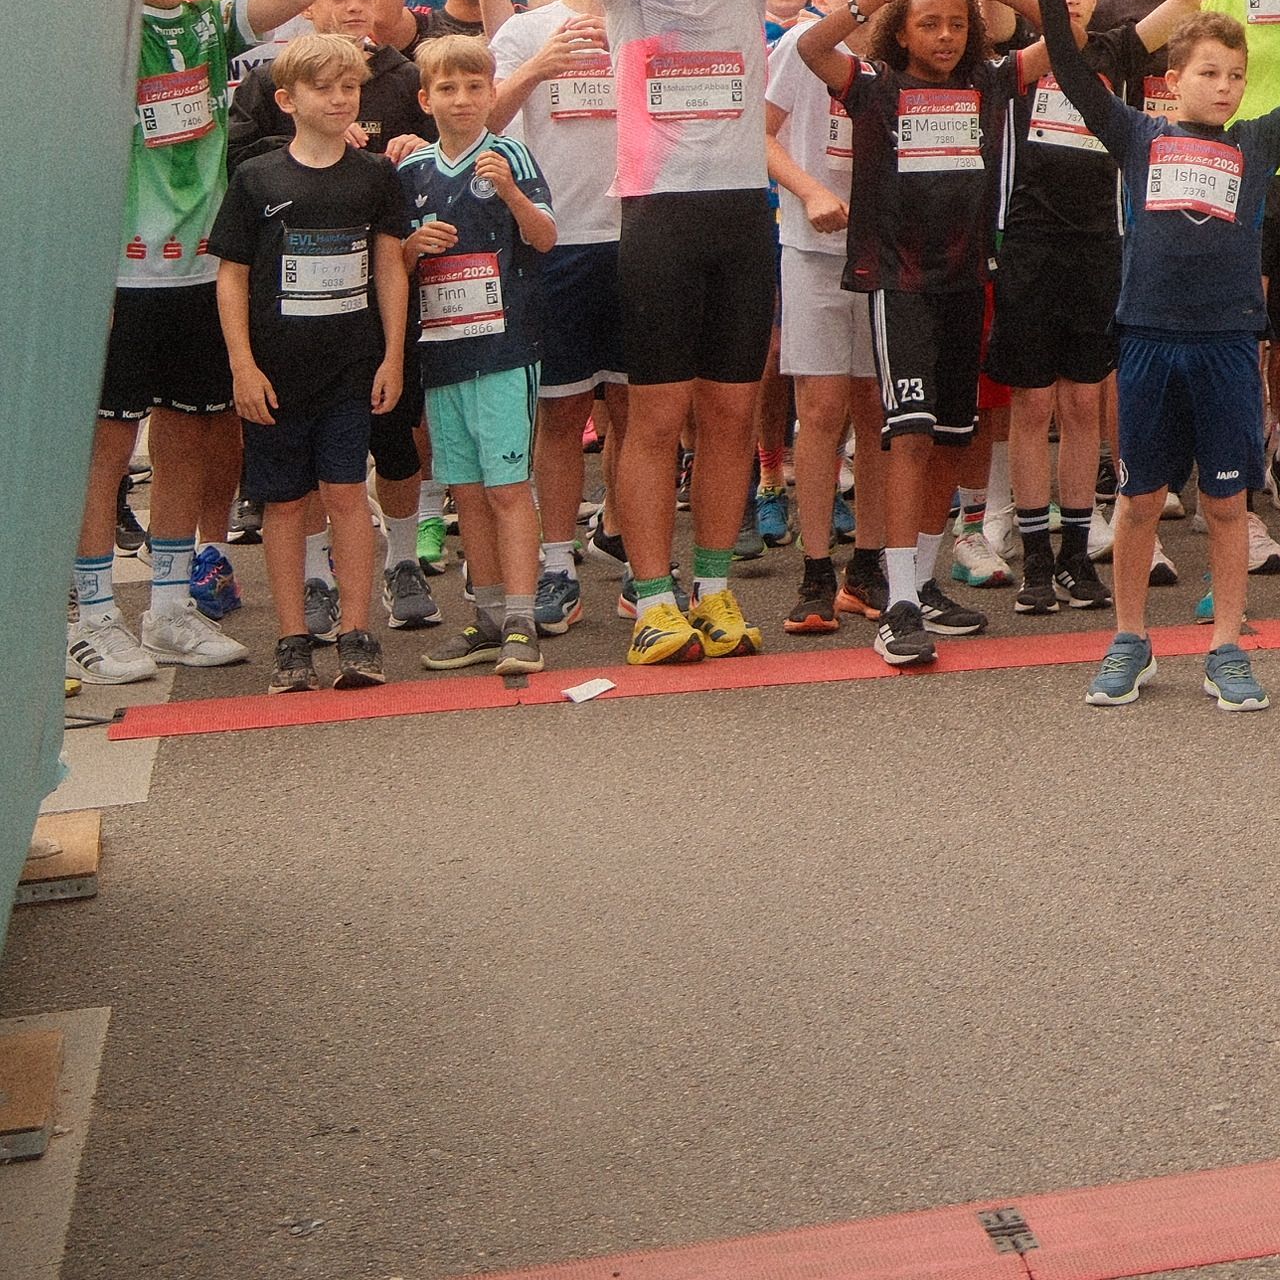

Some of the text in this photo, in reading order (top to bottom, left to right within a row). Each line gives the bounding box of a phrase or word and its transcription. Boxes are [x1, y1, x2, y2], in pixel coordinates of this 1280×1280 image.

[654, 63, 741, 78] Leverkusen 2026
[573, 81, 611, 95] Mats
[171, 99, 203, 117] Tom
[581, 98, 603, 107] 7410
[685, 98, 709, 108] 6856
[905, 102, 977, 114] Leverkusen 2026
[915, 118, 968, 132] Maurice
[935, 135, 955, 144] 7380
[953, 157, 976, 168] 7380
[1156, 151, 1214, 167] Leverkusen
[1213, 156, 1240, 173] 2026
[1174, 168, 1217, 188] Ishaq
[1183, 186, 1207, 198] 7378
[289, 233, 317, 246] EVL
[463, 265, 494, 278] 2026
[321, 278, 345, 287] 5038
[437, 286, 467, 302] Finn
[340, 298, 363, 312] 5038
[442, 304, 464, 314] 6866
[463, 322, 494, 336] 6866
[897, 377, 925, 403] 23
